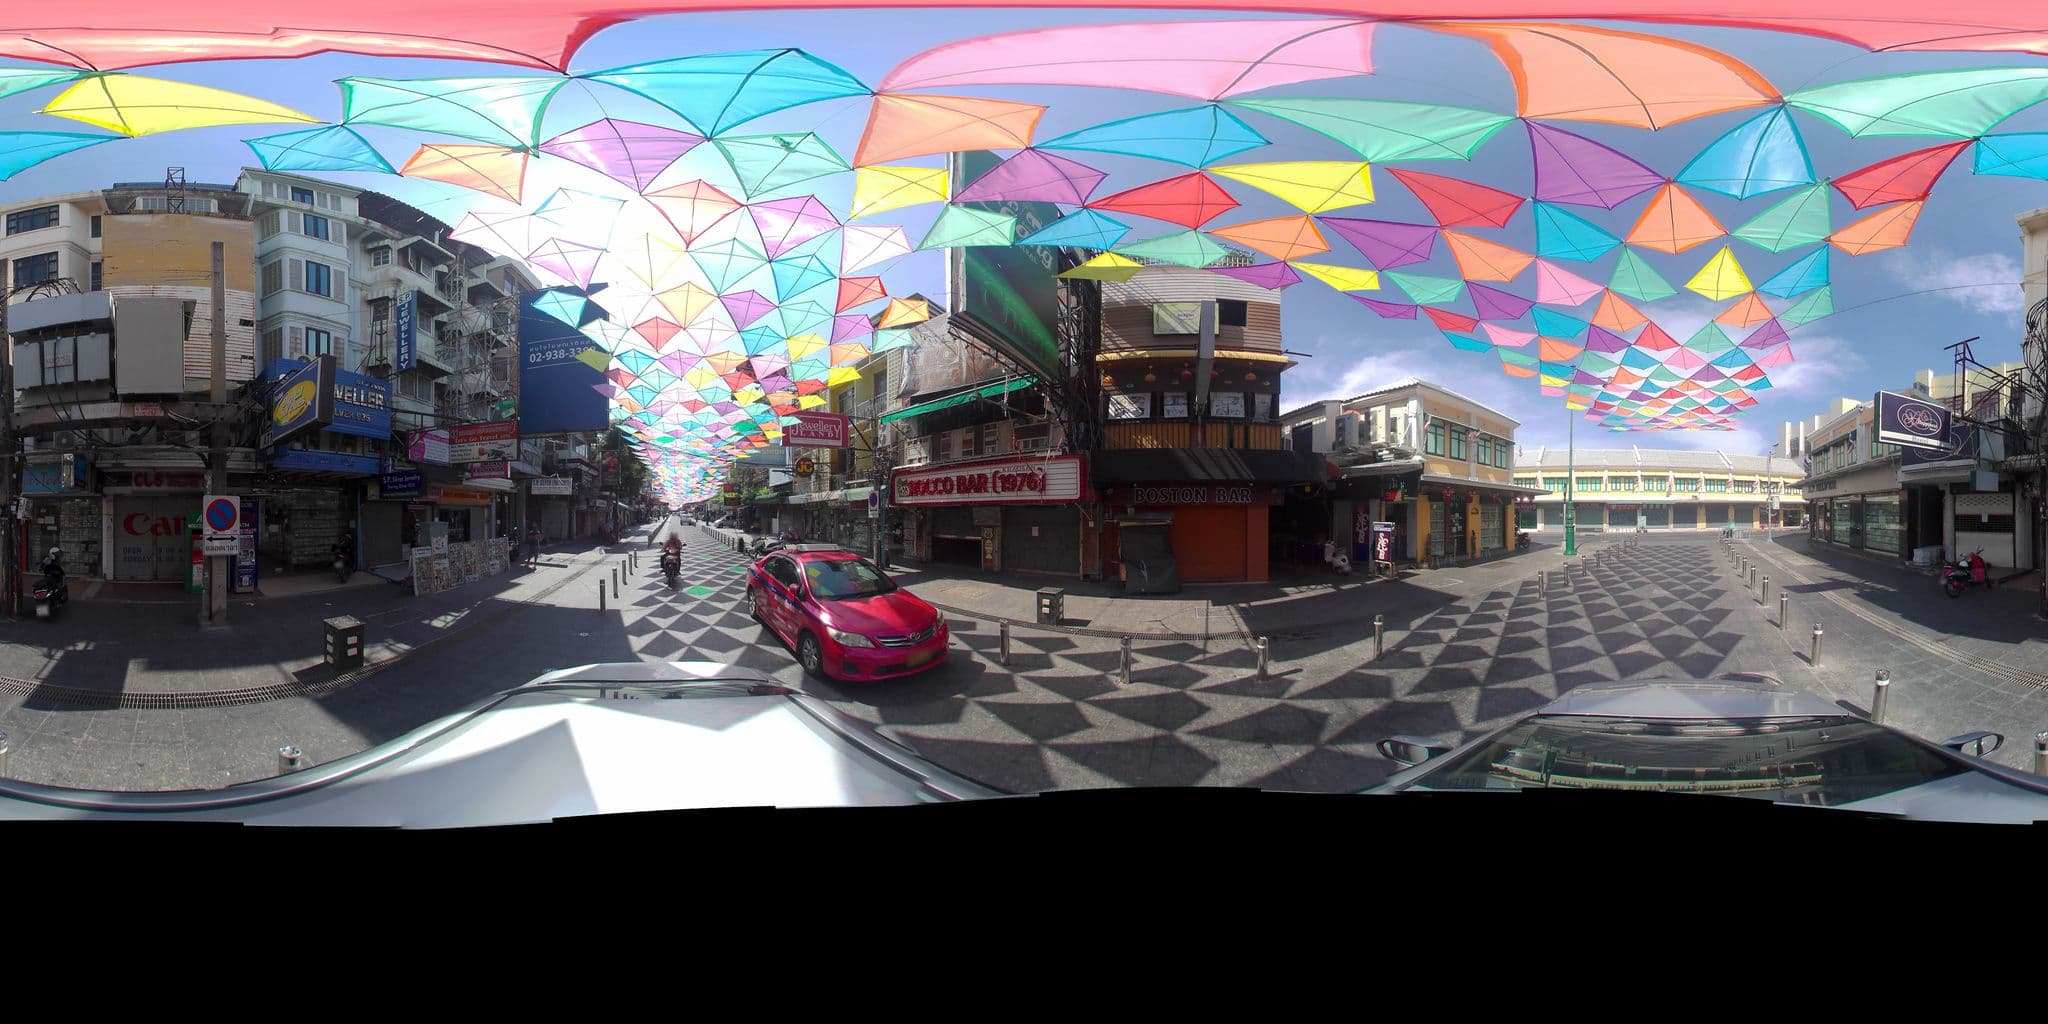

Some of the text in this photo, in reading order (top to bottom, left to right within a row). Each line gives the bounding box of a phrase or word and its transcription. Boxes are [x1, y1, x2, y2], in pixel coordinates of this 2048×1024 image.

[399, 303, 409, 369] JEWELLERY
[956, 472, 988, 494] BAR
[991, 467, 1047, 494] (1976)
[1134, 487, 1251, 503] BOSTON BAR
